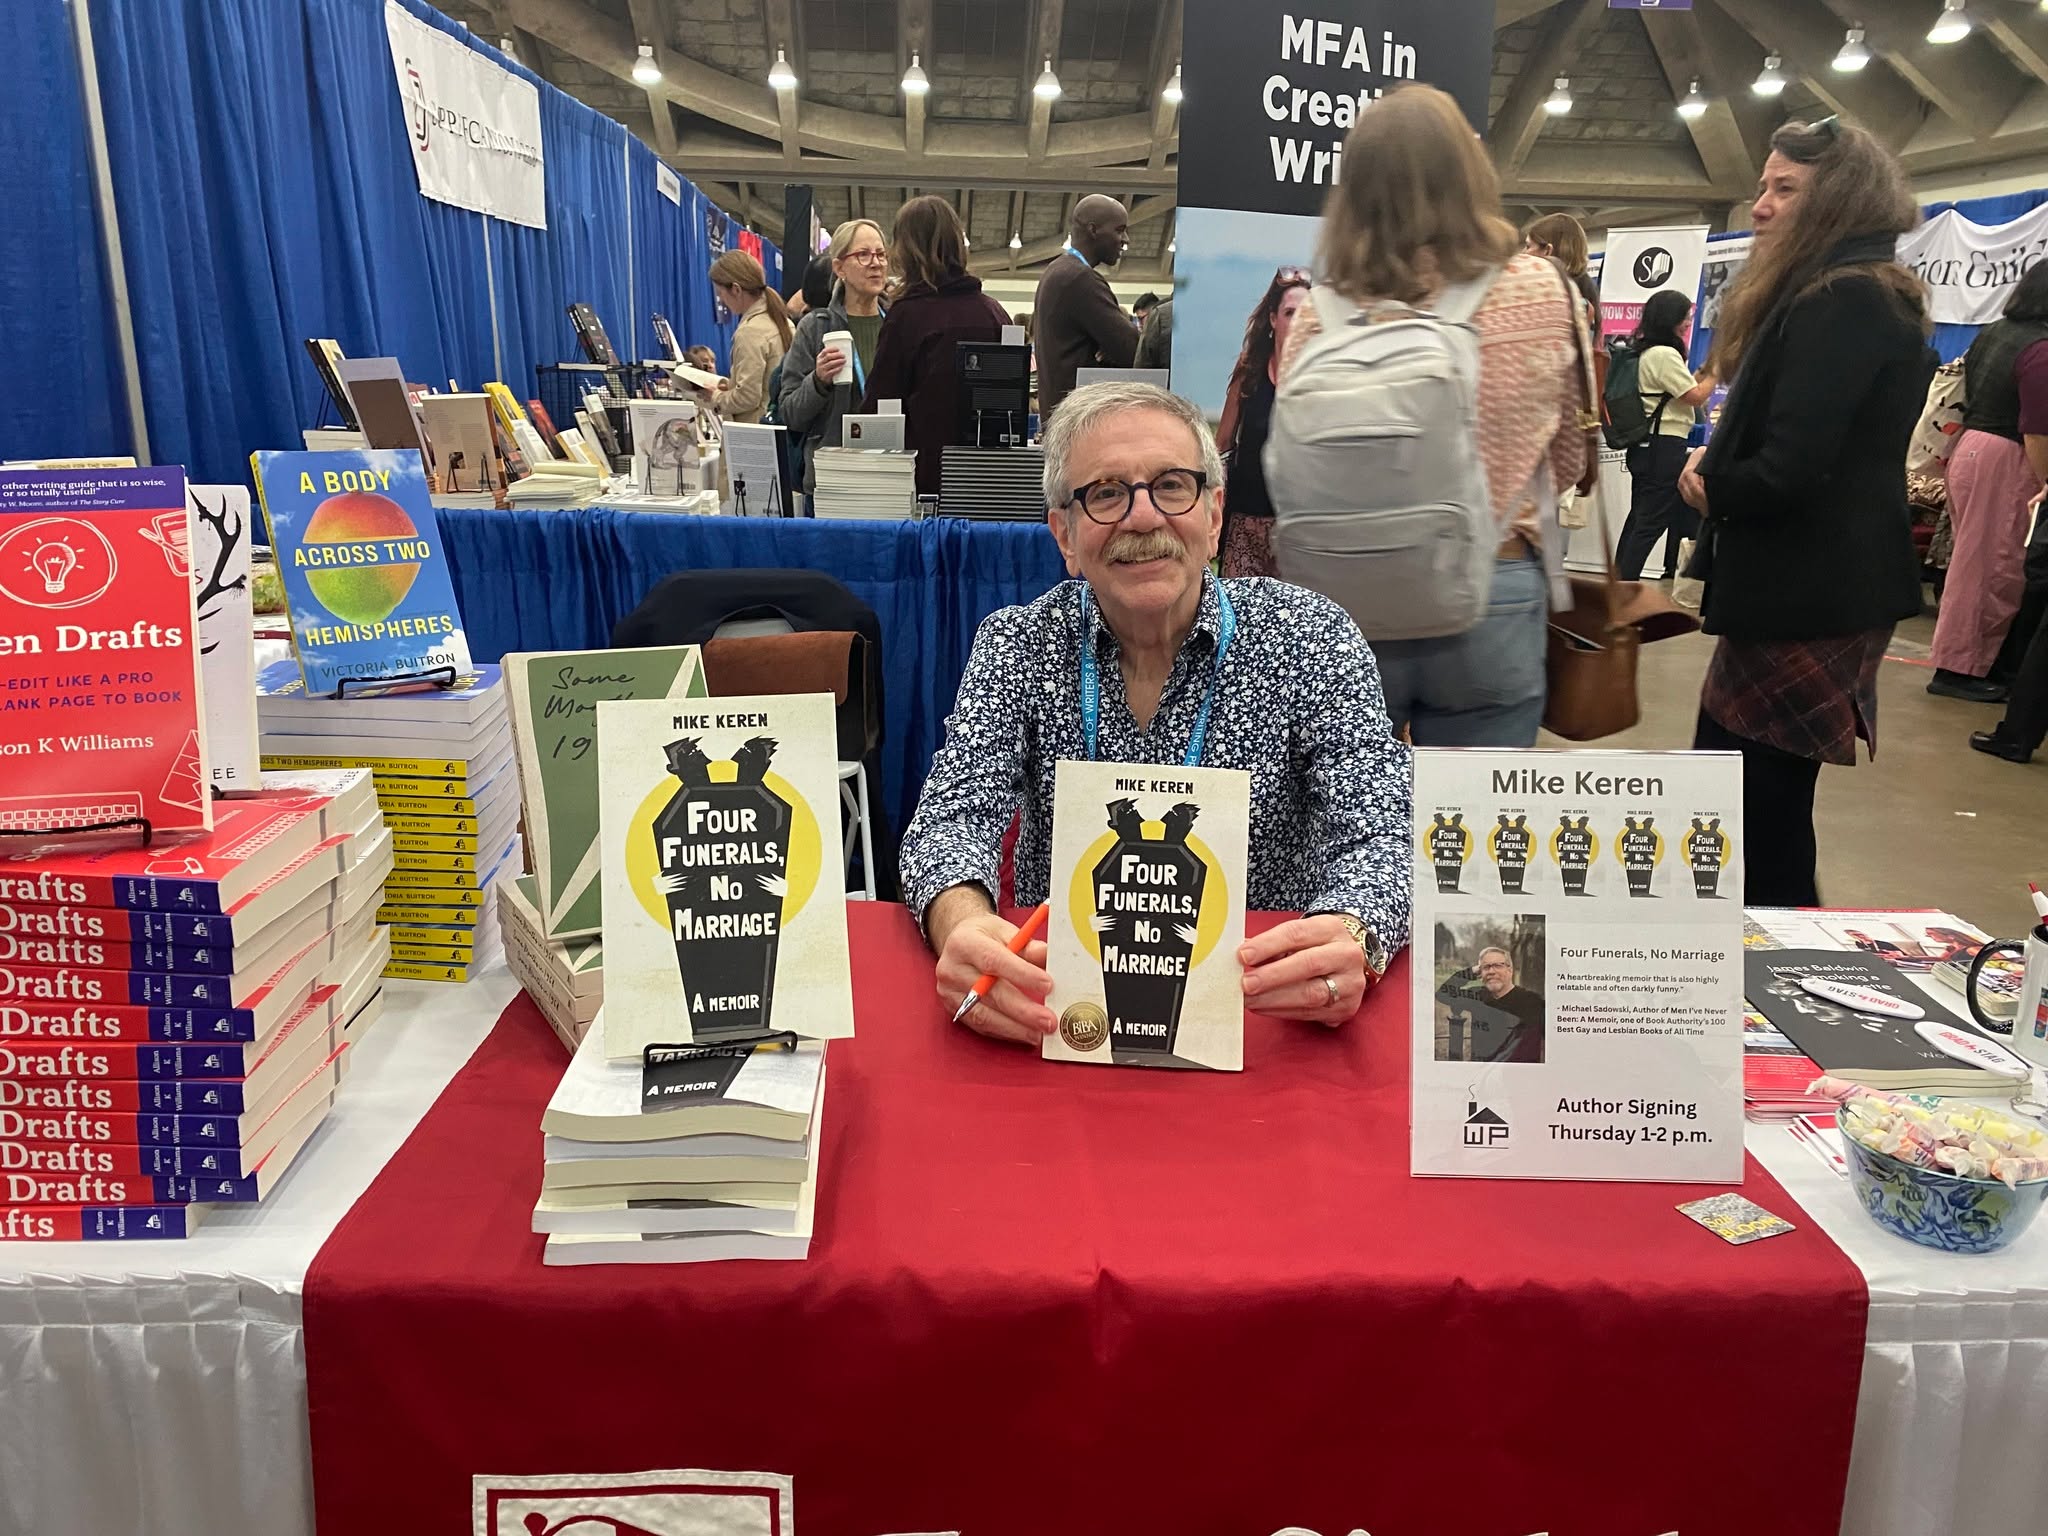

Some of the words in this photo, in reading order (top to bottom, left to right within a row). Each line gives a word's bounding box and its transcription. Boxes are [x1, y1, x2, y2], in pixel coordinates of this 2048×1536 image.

[1281, 14, 1371, 73] MFA
[1382, 31, 1416, 79] in
[1269, 136, 1342, 186] Wri
[1626, 306, 1643, 320] SIG
[2, 481, 30, 490] other
[31, 481, 67, 491] writing
[68, 480, 96, 490] guide
[98, 479, 118, 488] that
[119, 479, 128, 487] is
[142, 479, 166, 488] wise,
[30, 488, 61, 498] totally
[63, 487, 100, 497] useful!"
[300, 471, 316, 494] A
[324, 469, 390, 494] BODY
[45, 499, 69, 507] author
[92, 499, 109, 507] Story
[295, 545, 379, 567] ACROSS
[384, 541, 431, 562] TWO
[0, 633, 43, 656] en
[55, 620, 183, 652] Drafts
[305, 615, 454, 647] HEMISPHERES
[321, 661, 388, 678] VICTORIA
[396, 653, 456, 670] BUITRON
[1085, 663, 1095, 671] &
[0, 676, 49, 690] -EDIT
[56, 674, 92, 688] LIKE
[100, 674, 111, 685] A
[118, 672, 154, 684] PRO
[552, 666, 635, 690] Some
[0, 697, 41, 711] ANK
[49, 695, 96, 708] PAGE
[103, 693, 127, 705] TO
[134, 691, 182, 704] BOOK
[1084, 671, 1095, 715] WRITERS
[673, 715, 709, 729] MIKE
[716, 713, 768, 728] KEREN
[1086, 715, 1094, 732] OF
[0, 742, 31, 756] son
[38, 738, 54, 753] K
[60, 734, 154, 752] Williams
[553, 735, 592, 761] 19
[261, 757, 274, 765] OSS
[277, 758, 292, 766] TWO
[294, 759, 342, 767] HEMISPHERES
[355, 761, 385, 769] VICTORIA
[388, 762, 418, 770] BUITRON
[389, 783, 418, 791] BUITRON
[1115, 778, 1146, 792] MIKE
[1150, 780, 1194, 794] KEREN
[1492, 769, 1565, 794] Mike
[1575, 771, 1664, 796] Keren
[687, 801, 758, 835] FOUR
[400, 839, 429, 847] BUITRON
[662, 836, 785, 868] FUNERALS,
[1120, 854, 1178, 885] FOUR
[0, 872, 87, 904] rafts
[710, 875, 743, 901] NO
[1098, 883, 1197, 918] FUNERALS,
[674, 908, 776, 941] MARRIAGE
[1134, 920, 1161, 943] NO
[1103, 945, 1186, 977] MARRIAGE
[1560, 947, 1588, 957] Four
[1592, 948, 1647, 960] Funerals,
[1651, 950, 1667, 959] No
[1672, 950, 1724, 962] Marriage
[1567, 974, 1620, 983] heartbreaking
[1696, 976, 1719, 984] highly
[1767, 964, 1810, 973] James
[1812, 964, 1869, 973] Baldwin
[0, 968, 102, 1000] Drafts
[1632, 985, 1655, 993] darkly
[693, 994, 705, 1013] A
[709, 995, 760, 1012] MEMOIR
[1593, 1005, 1631, 1014] Sadowski,
[1633, 1006, 1659, 1014] Author
[1, 1007, 121, 1037] Drafts
[1112, 1017, 1122, 1034] A
[1126, 1022, 1167, 1037] MEMOIR
[1576, 1027, 1591, 1035] Gay
[1588, 1016, 1618, 1024] Memoir,
[1667, 1018, 1709, 1026] Authority's
[0, 1047, 109, 1076] Drafts
[0, 1079, 112, 1108] Drafts
[646, 1085, 659, 1096] A
[664, 1081, 718, 1094] MEMOIR
[1557, 1098, 1623, 1114] Author
[1628, 1099, 1697, 1119] Signing
[0, 1110, 111, 1141] Drafts
[1464, 1126, 1509, 1145] WP
[1548, 1125, 1636, 1145] Thursday
[1641, 1126, 1667, 1142] 1-2
[1672, 1129, 1713, 1146] p.m.
[1, 1142, 113, 1172] Drafts
[7, 1174, 126, 1202] Drafts
